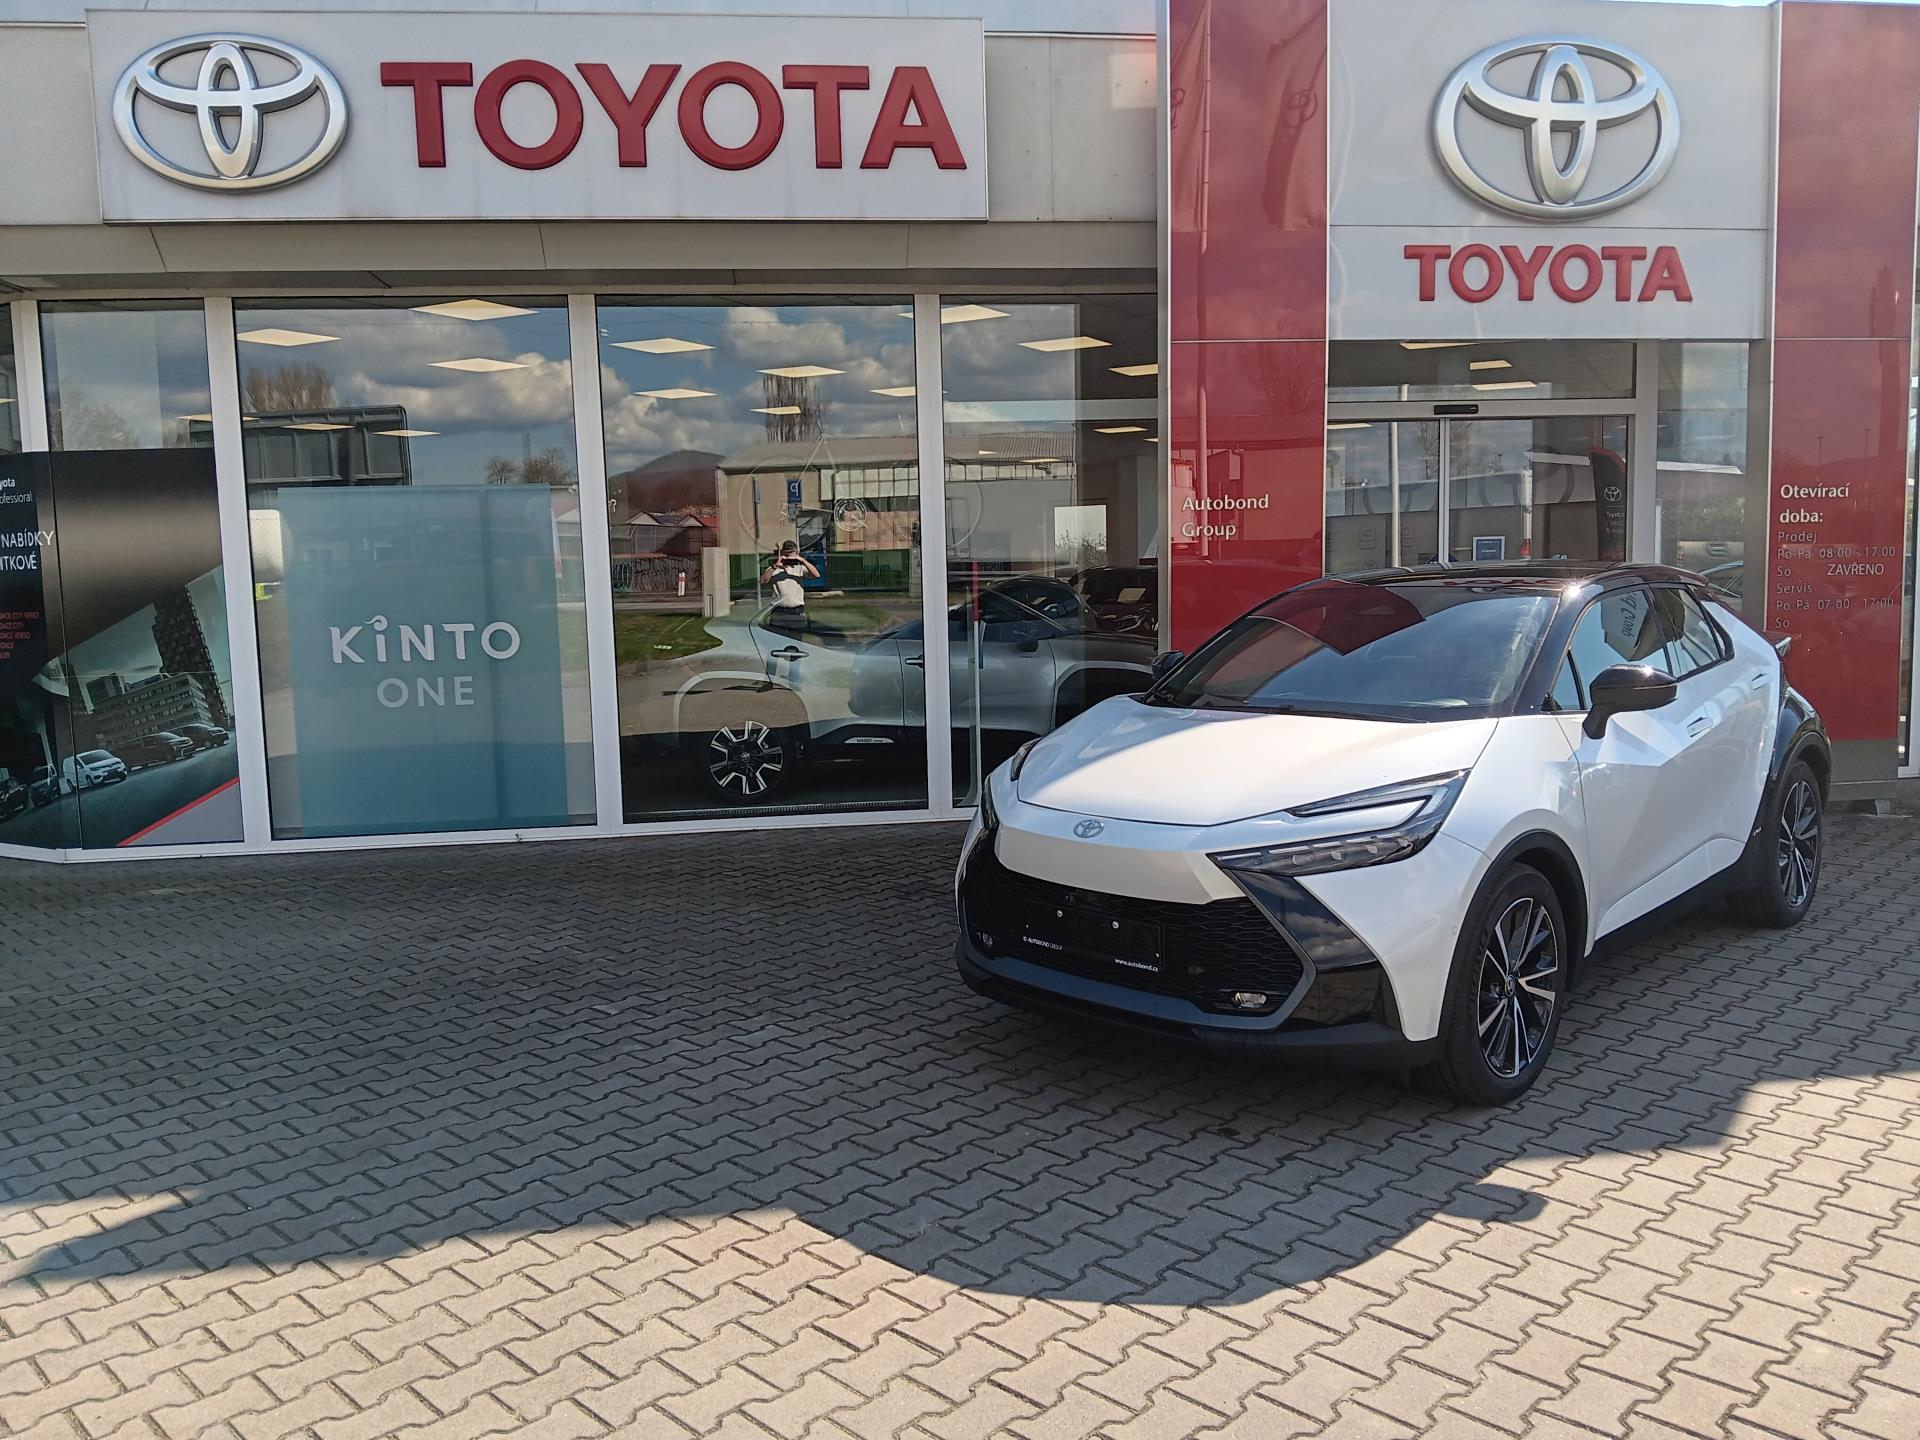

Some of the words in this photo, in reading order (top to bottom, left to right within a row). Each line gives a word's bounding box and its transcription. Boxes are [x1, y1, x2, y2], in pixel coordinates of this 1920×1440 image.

[380, 58, 968, 171] TOYOTA
[1403, 243, 1693, 303] TOYOTA
[1780, 482, 1850, 499] Otevírací
[1182, 493, 1269, 511] Autobond
[1779, 508, 1824, 523] doba:
[1, 528, 54, 549] NABÍDKY
[1181, 522, 1237, 540] Group
[1778, 531, 1817, 544] Prodej
[1777, 566, 1791, 577] So
[1827, 563, 1884, 576] ZAVŘENO
[1776, 583, 1813, 594] Servis
[1775, 617, 1790, 628] So
[376, 675, 475, 708] ONE
